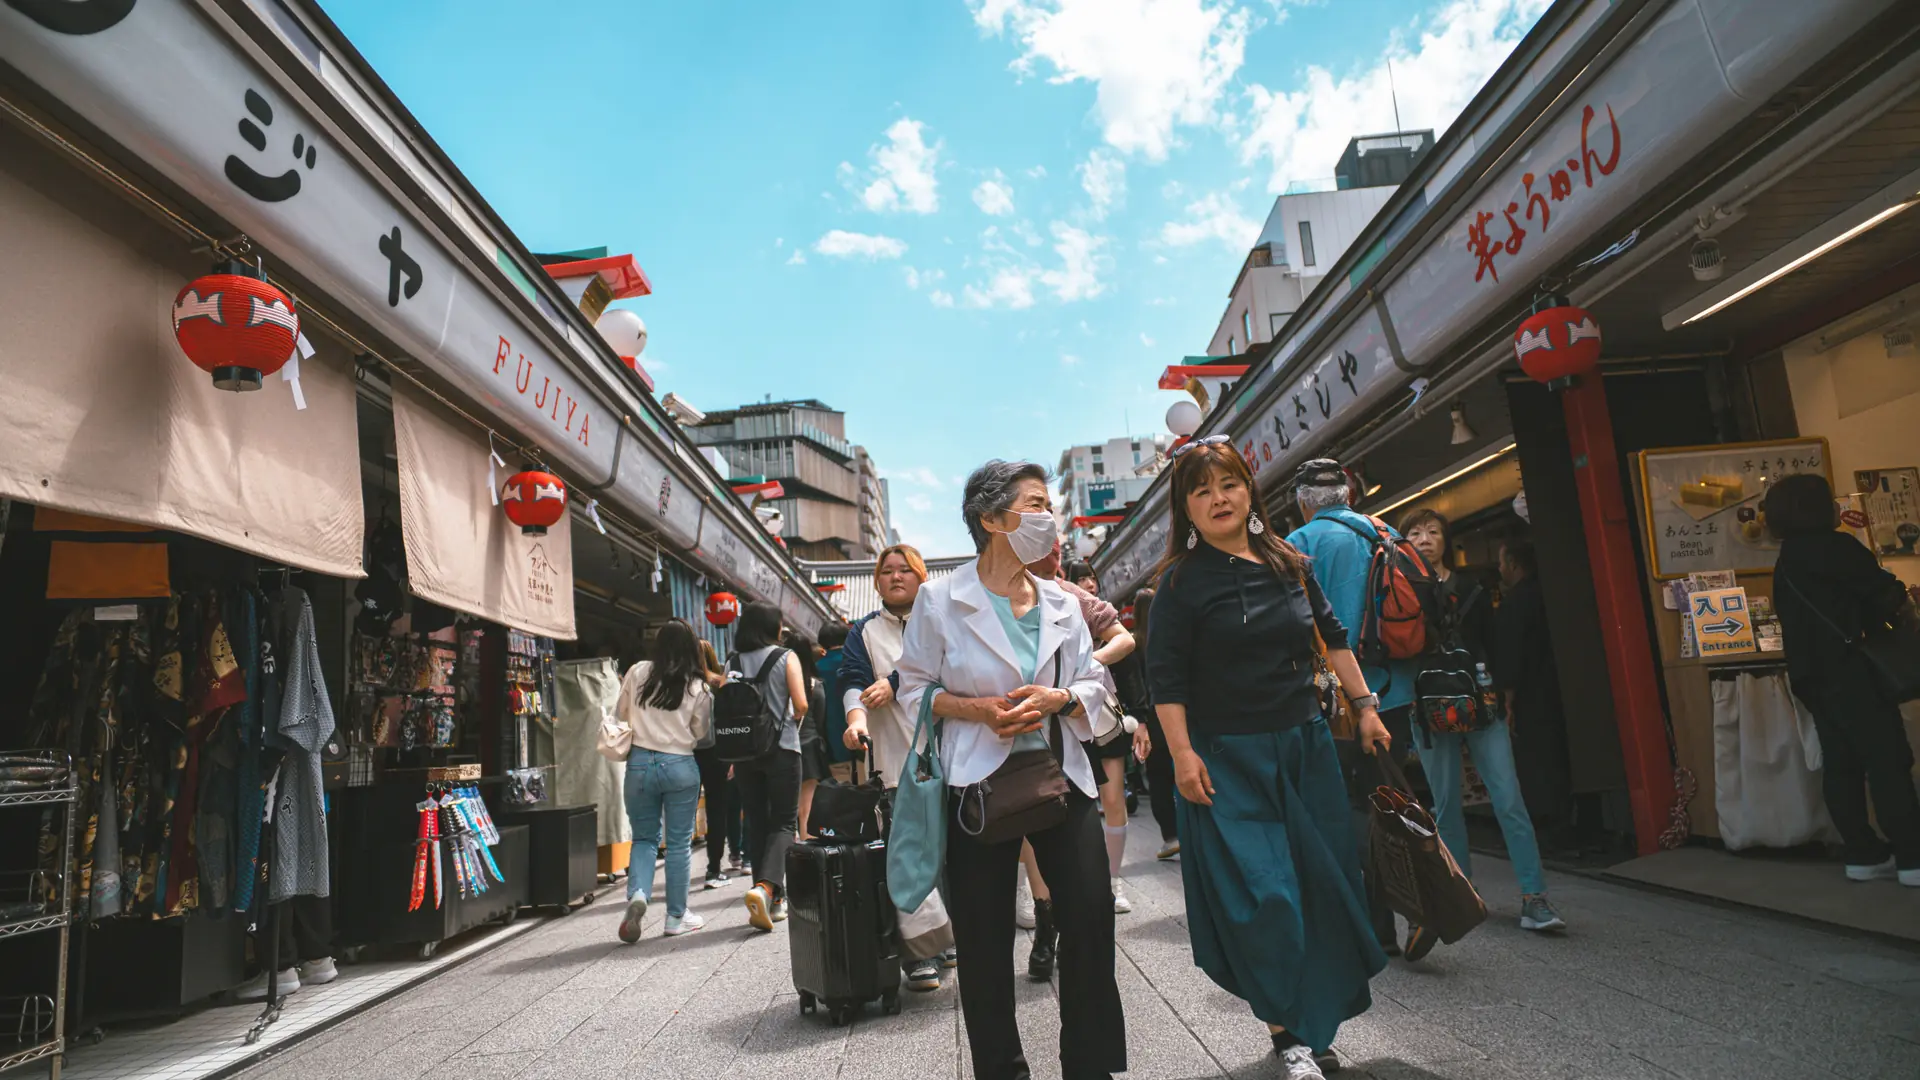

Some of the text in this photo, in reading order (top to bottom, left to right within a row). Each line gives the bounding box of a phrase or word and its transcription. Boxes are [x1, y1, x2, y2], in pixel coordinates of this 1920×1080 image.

[492, 335, 589, 447] FUJIYA
[1743, 456, 1820, 473] 芋ようかん
[1665, 522, 1718, 538] あんこ玉
[1680, 540, 1702, 549] Bean
[1694, 595, 1744, 617] 入口
[1702, 639, 1753, 651] Entrance
